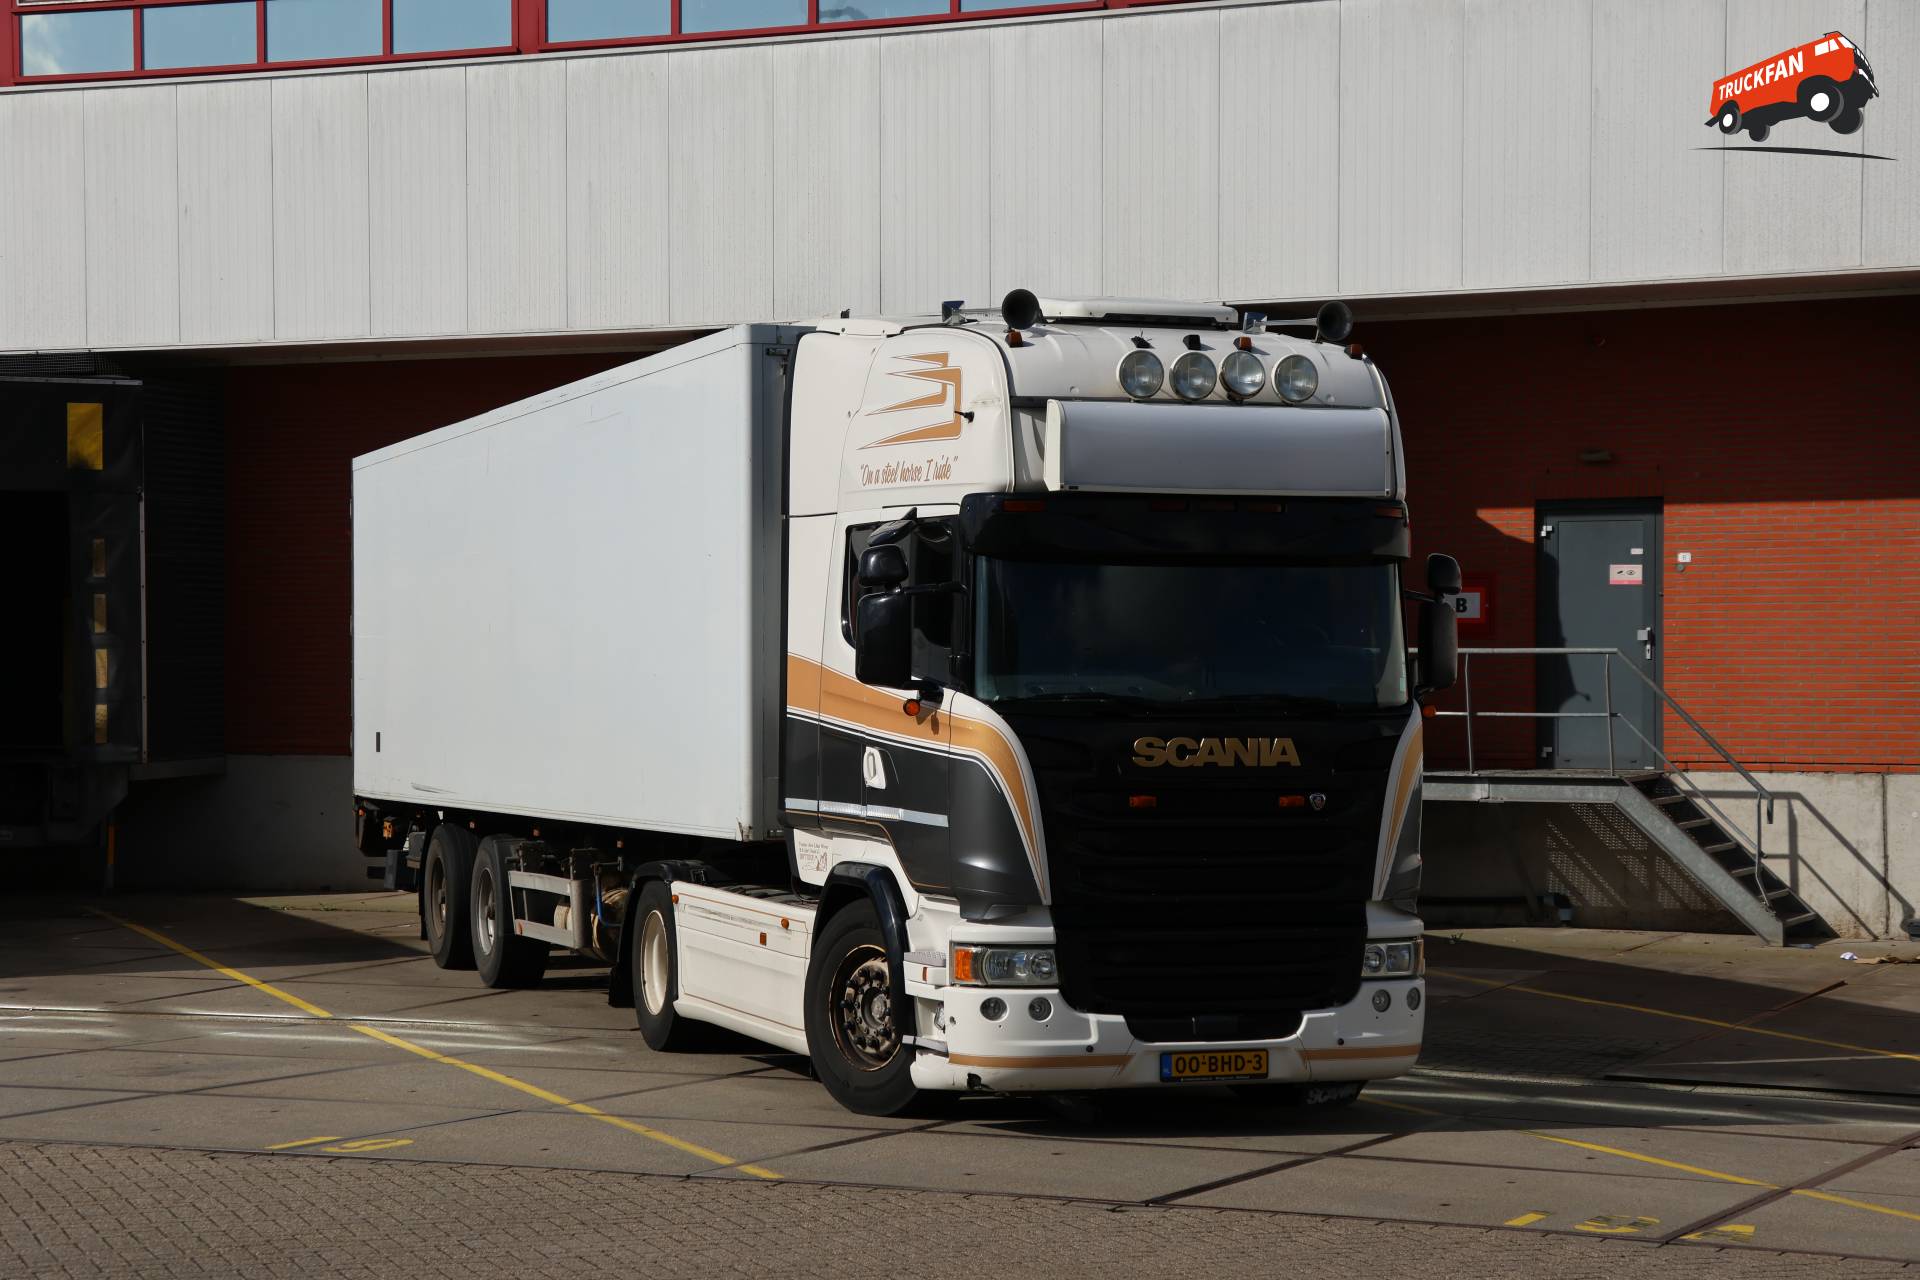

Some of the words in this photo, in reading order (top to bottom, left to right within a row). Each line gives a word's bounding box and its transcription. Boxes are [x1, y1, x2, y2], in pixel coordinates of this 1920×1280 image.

[874, 468, 881, 485] a
[881, 460, 900, 485] steel
[900, 460, 922, 482] horse
[924, 458, 933, 482] I
[1456, 597, 1468, 613] B
[1132, 736, 1302, 768] SCANIA
[1175, 1054, 1263, 1074] 00-BHD-3
